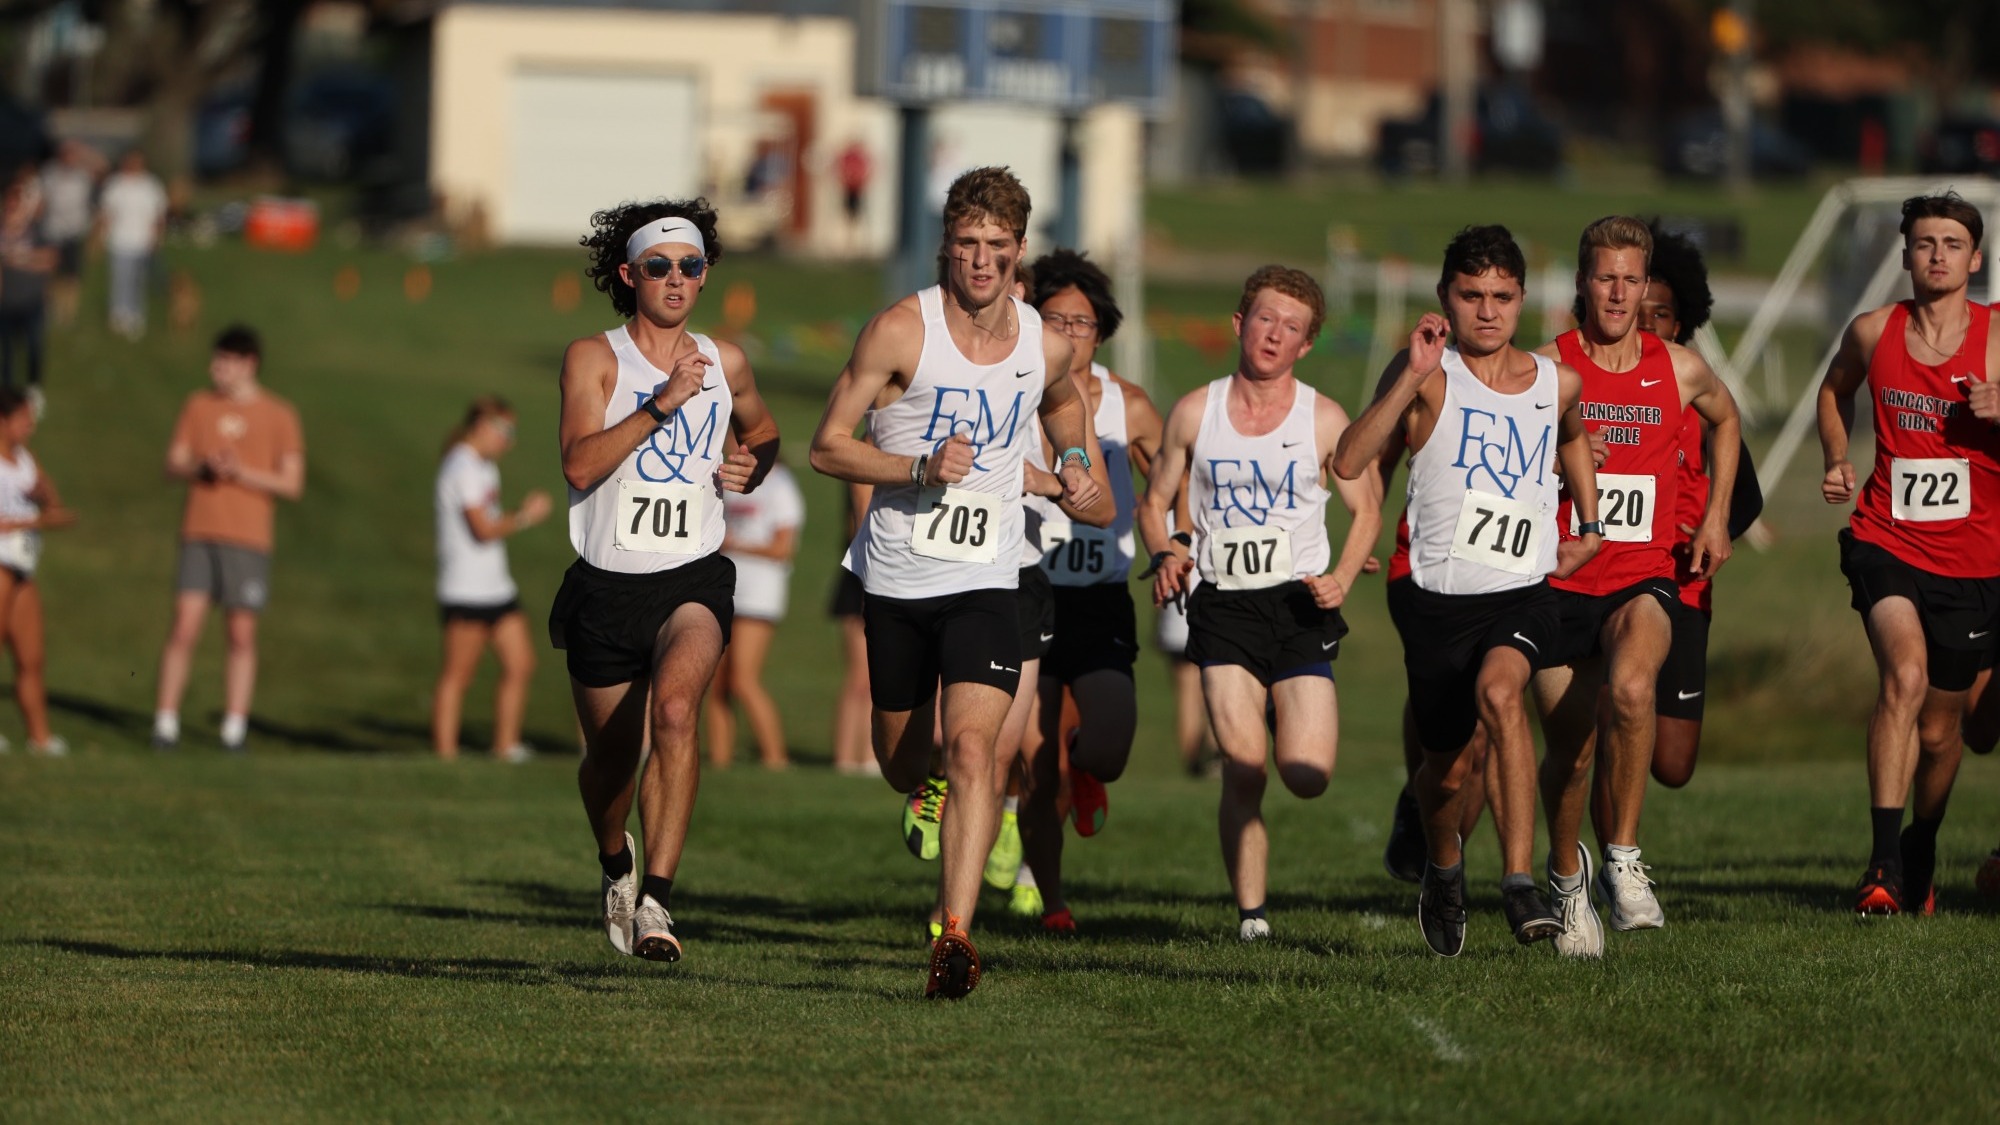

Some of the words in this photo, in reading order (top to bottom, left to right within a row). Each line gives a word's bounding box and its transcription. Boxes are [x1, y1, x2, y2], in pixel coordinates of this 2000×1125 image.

[1579, 402, 1661, 425] LANCASTER
[1881, 387, 1959, 417] LANCASTER
[1897, 411, 1937, 433] BIBLE
[1451, 407, 1551, 500] F&M
[1207, 459, 1298, 528] F&M
[1598, 488, 1644, 527] 20
[1902, 472, 1959, 507] 722
[629, 496, 689, 538] 701
[926, 502, 989, 547] 703
[1467, 507, 1532, 558] 710
[1049, 537, 1104, 574] 705
[1223, 538, 1278, 576] 707
